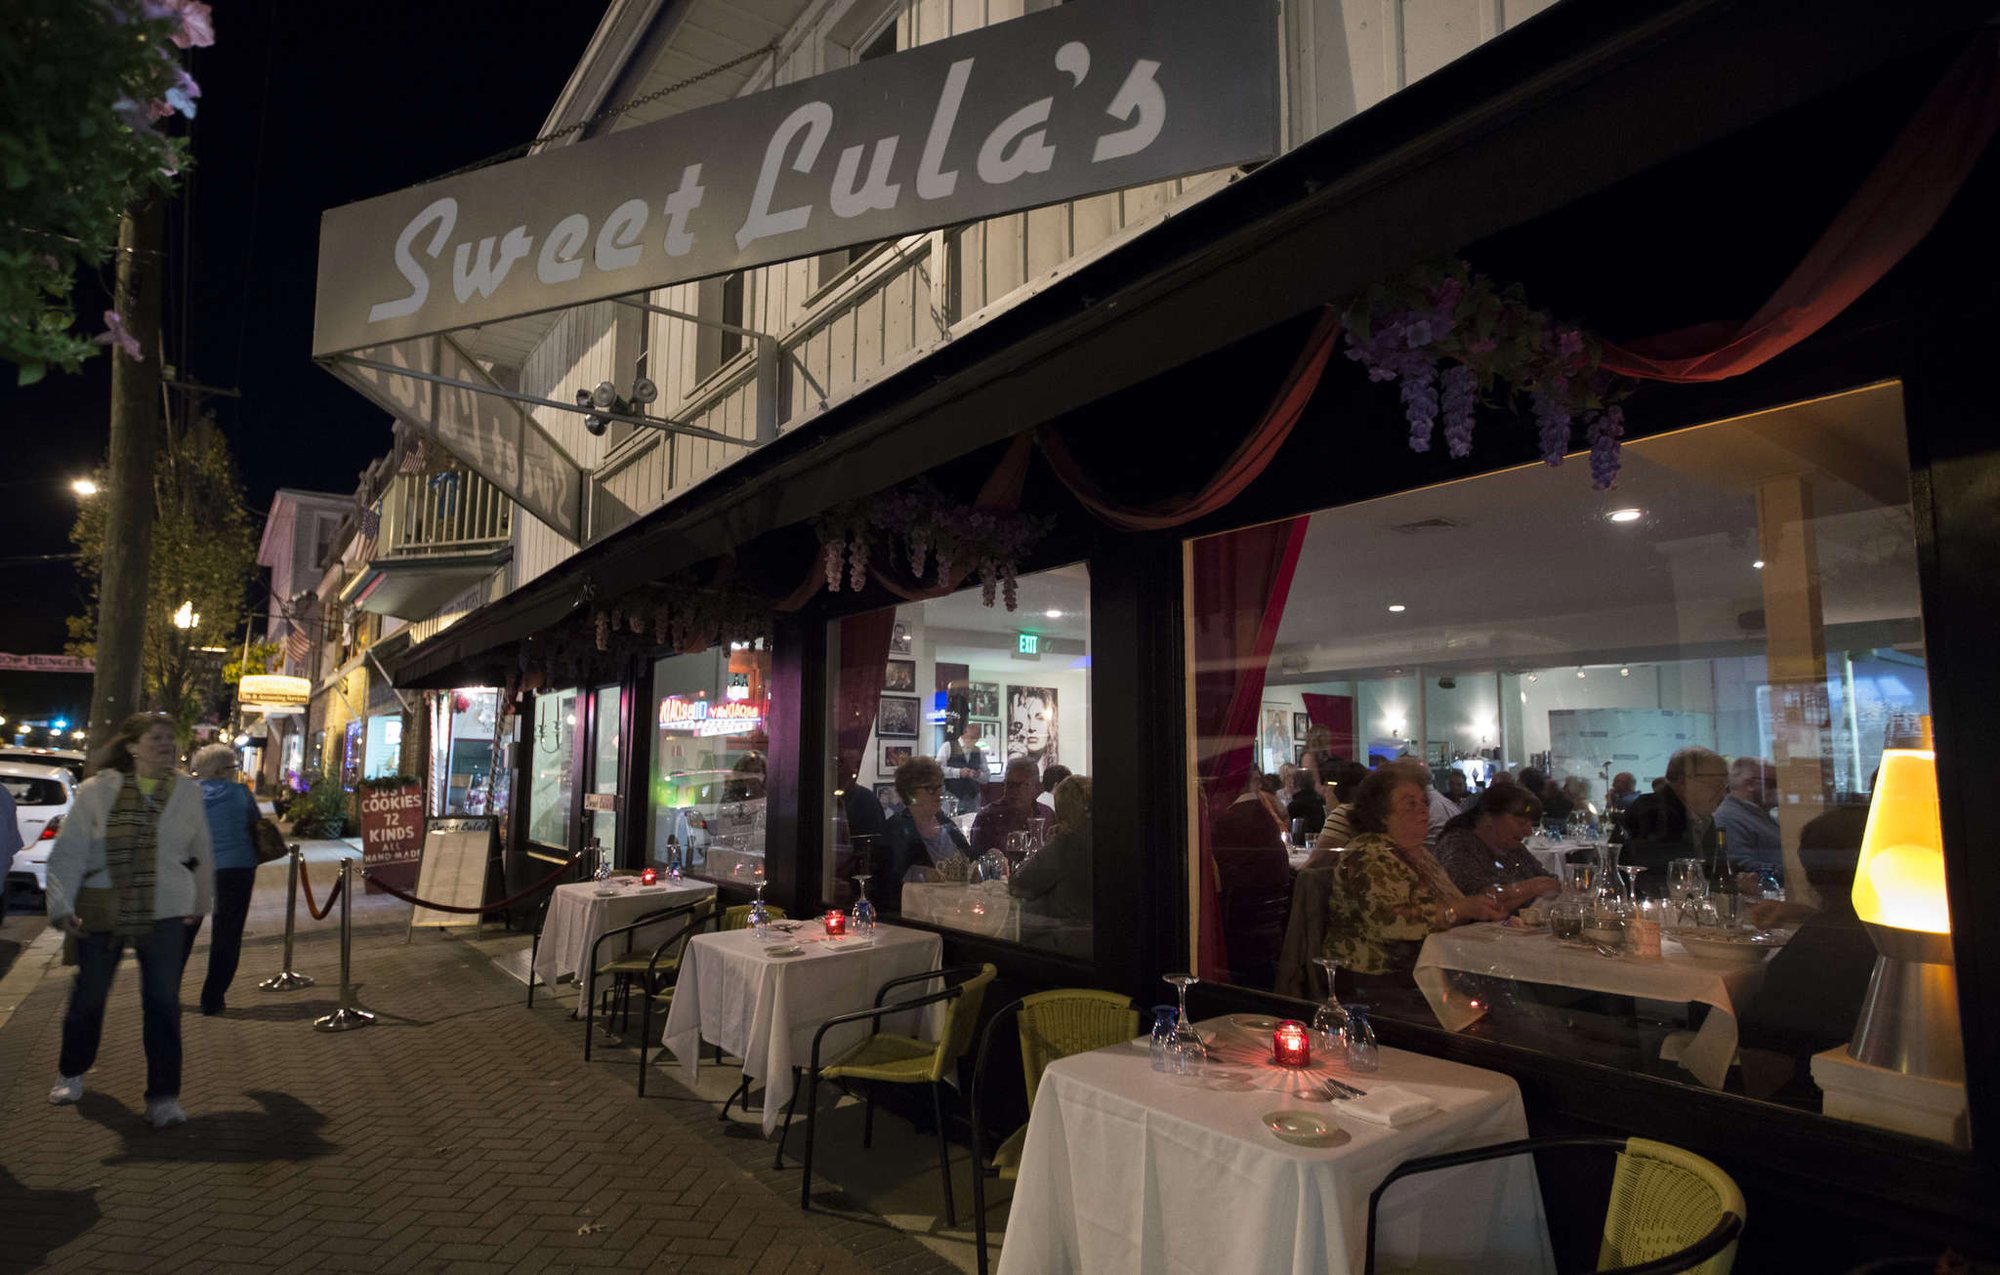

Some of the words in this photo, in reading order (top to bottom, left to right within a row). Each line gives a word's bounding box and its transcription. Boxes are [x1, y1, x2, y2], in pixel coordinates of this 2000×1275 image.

[368, 163, 706, 324] Sweet
[734, 41, 1167, 253] Lula's
[1019, 634, 1039, 654] EXIT
[361, 794, 422, 813] COOKIES
[384, 812, 400, 826] 72
[368, 825, 415, 842] KINDS
[382, 841, 401, 852] ALL
